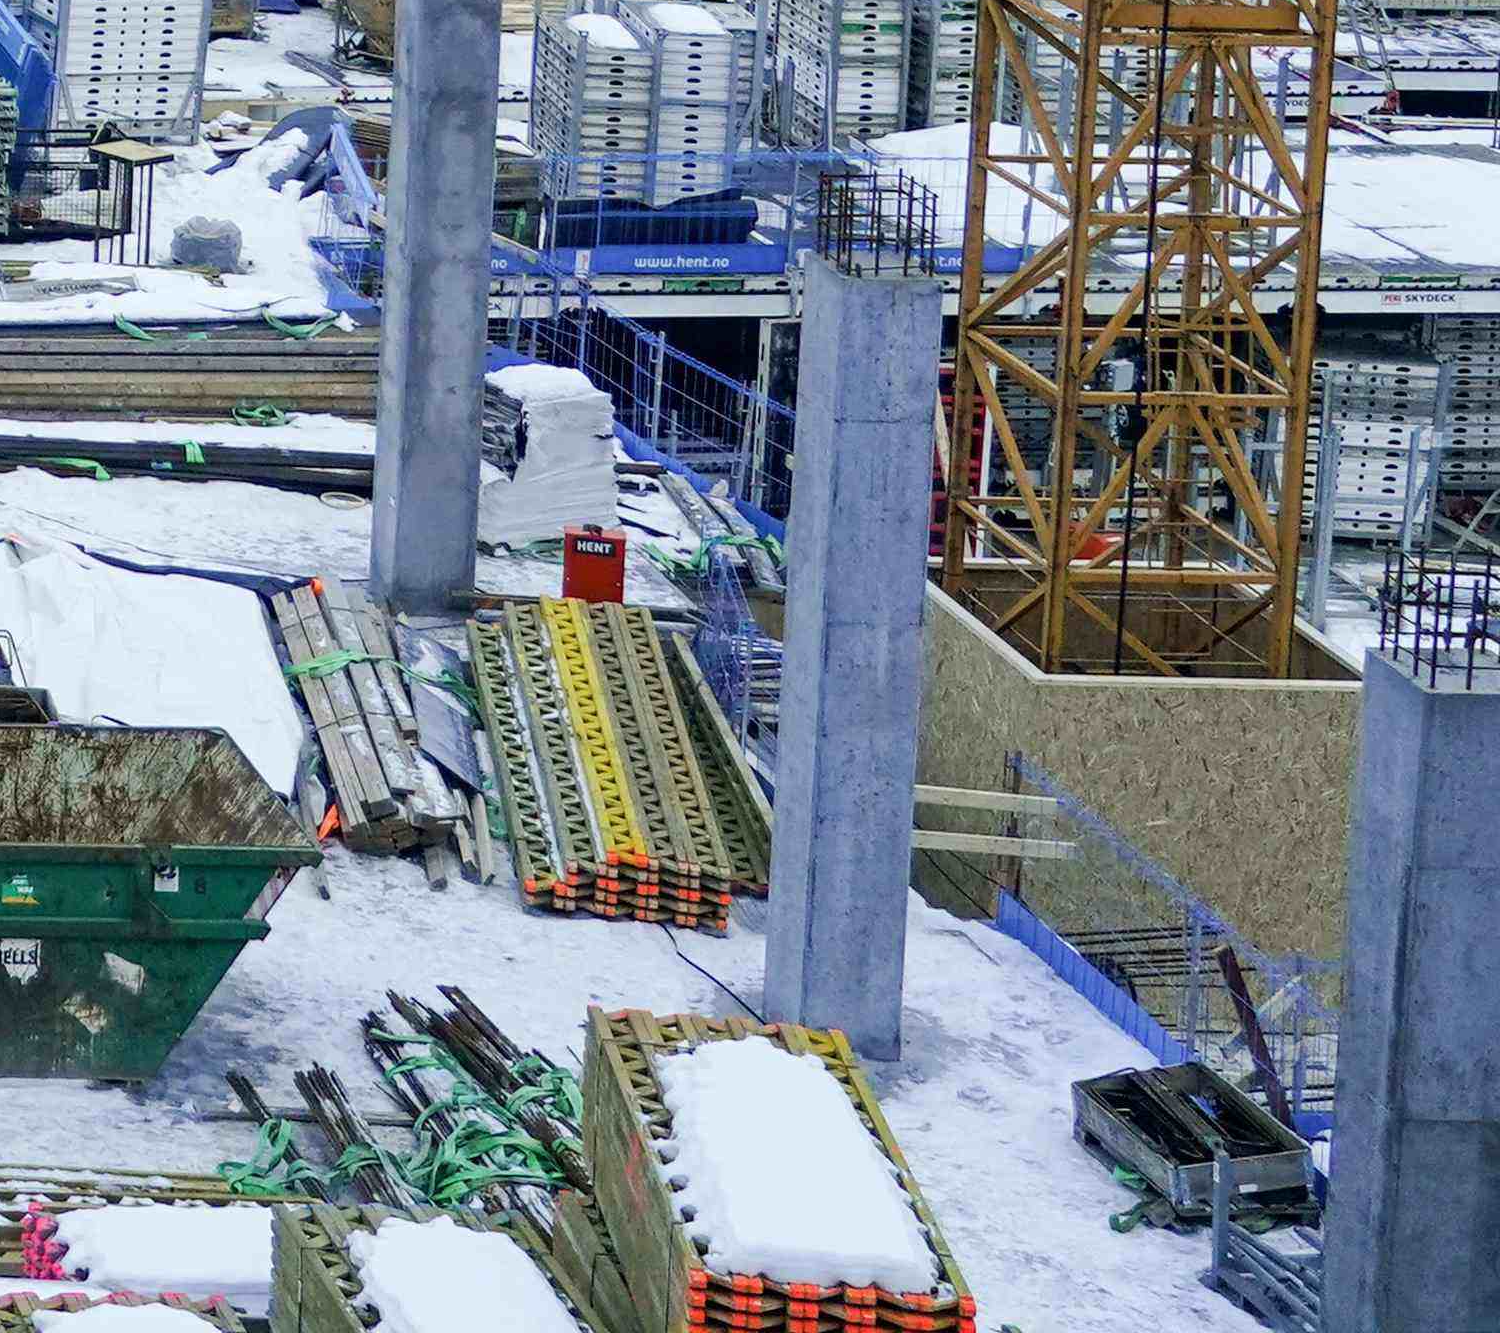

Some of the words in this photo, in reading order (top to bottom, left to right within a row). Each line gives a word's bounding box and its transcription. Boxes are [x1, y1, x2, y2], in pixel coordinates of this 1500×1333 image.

[633, 254, 731, 270] www.hent.no
[1404, 294, 1456, 302] SKYDECK
[576, 540, 613, 554] HENT
